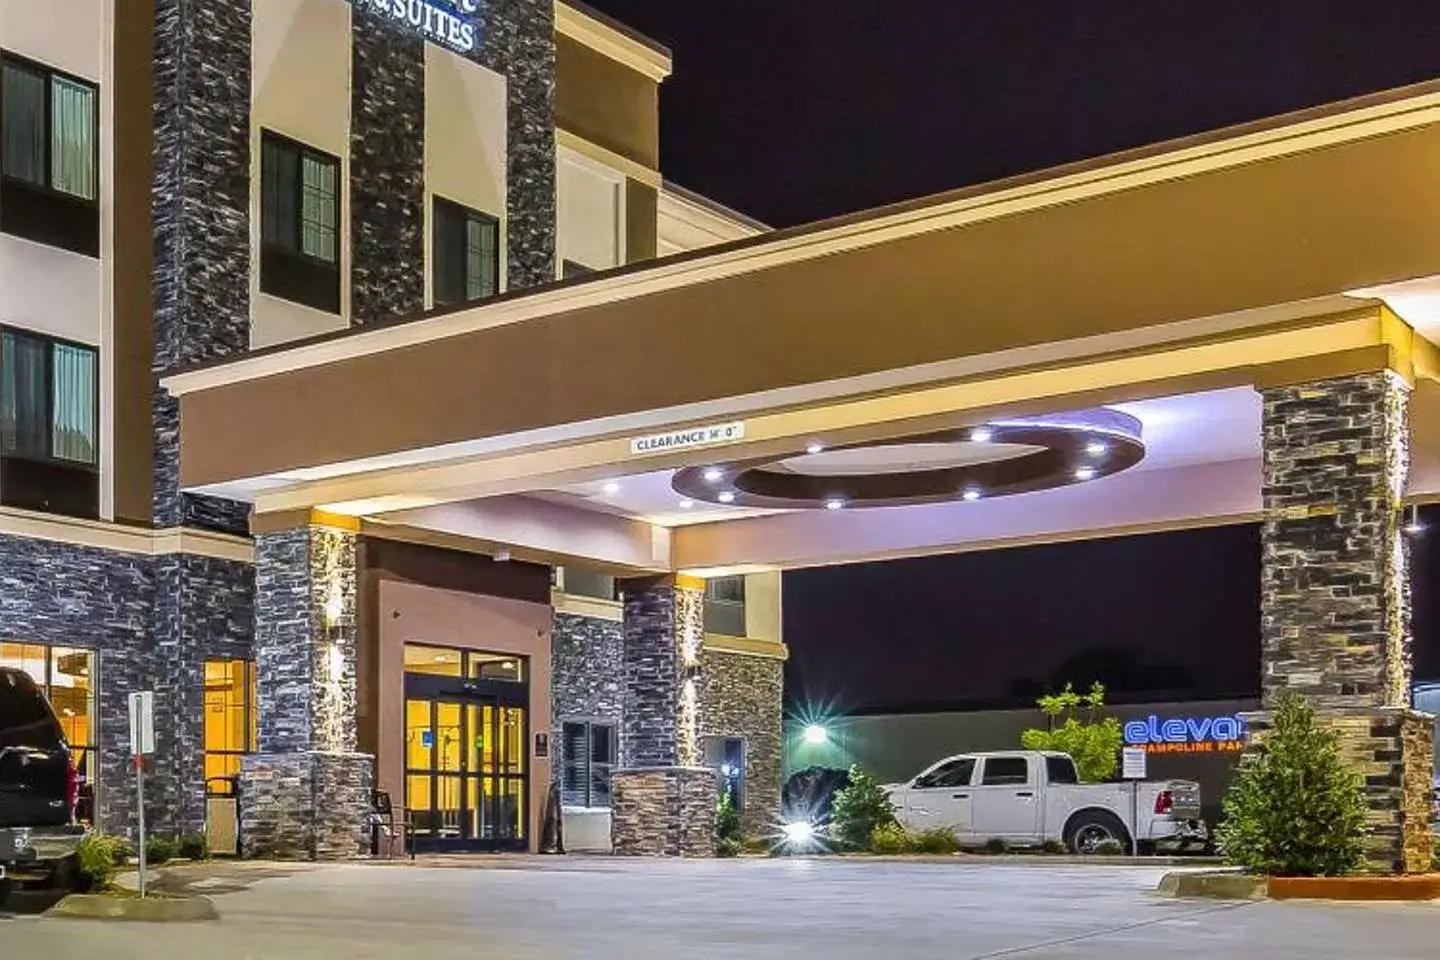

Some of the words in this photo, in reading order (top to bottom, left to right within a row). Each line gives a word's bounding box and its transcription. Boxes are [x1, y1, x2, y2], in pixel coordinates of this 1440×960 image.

[636, 431, 706, 451] CLEARANCE
[1124, 715, 1243, 743] eleva
[1132, 742, 1213, 753] RAMPOLINE
